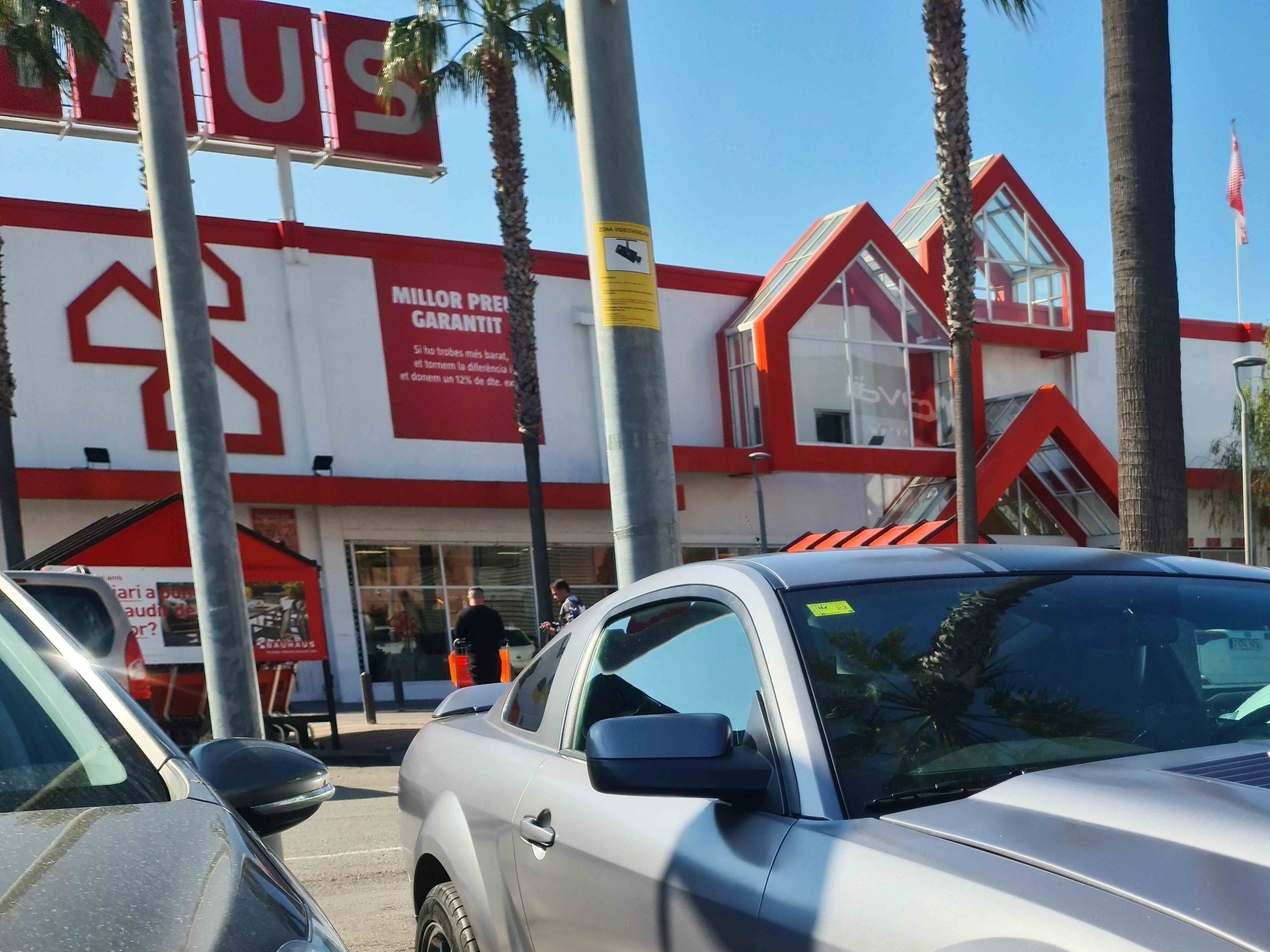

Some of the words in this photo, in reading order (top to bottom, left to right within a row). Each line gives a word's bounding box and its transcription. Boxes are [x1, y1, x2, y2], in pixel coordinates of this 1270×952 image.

[391, 286, 463, 309] MILLOR
[411, 310, 502, 334] GARANTIT
[413, 345, 422, 354] Si
[424, 346, 435, 355] ho
[436, 347, 463, 358] trobes
[465, 349, 483, 359] més
[484, 350, 509, 362] barat,
[413, 360, 423, 368] et
[424, 360, 456, 370] tornem
[457, 362, 466, 371] la
[400, 373, 409, 381] et
[411, 373, 441, 382] donem
[456, 375, 472, 385] 12%
[474, 377, 485, 385] de
[145, 588, 156, 599] a
[159, 586, 196, 602] pun
[175, 603, 198, 618] de
[265, 641, 315, 649] BAUHAUS
